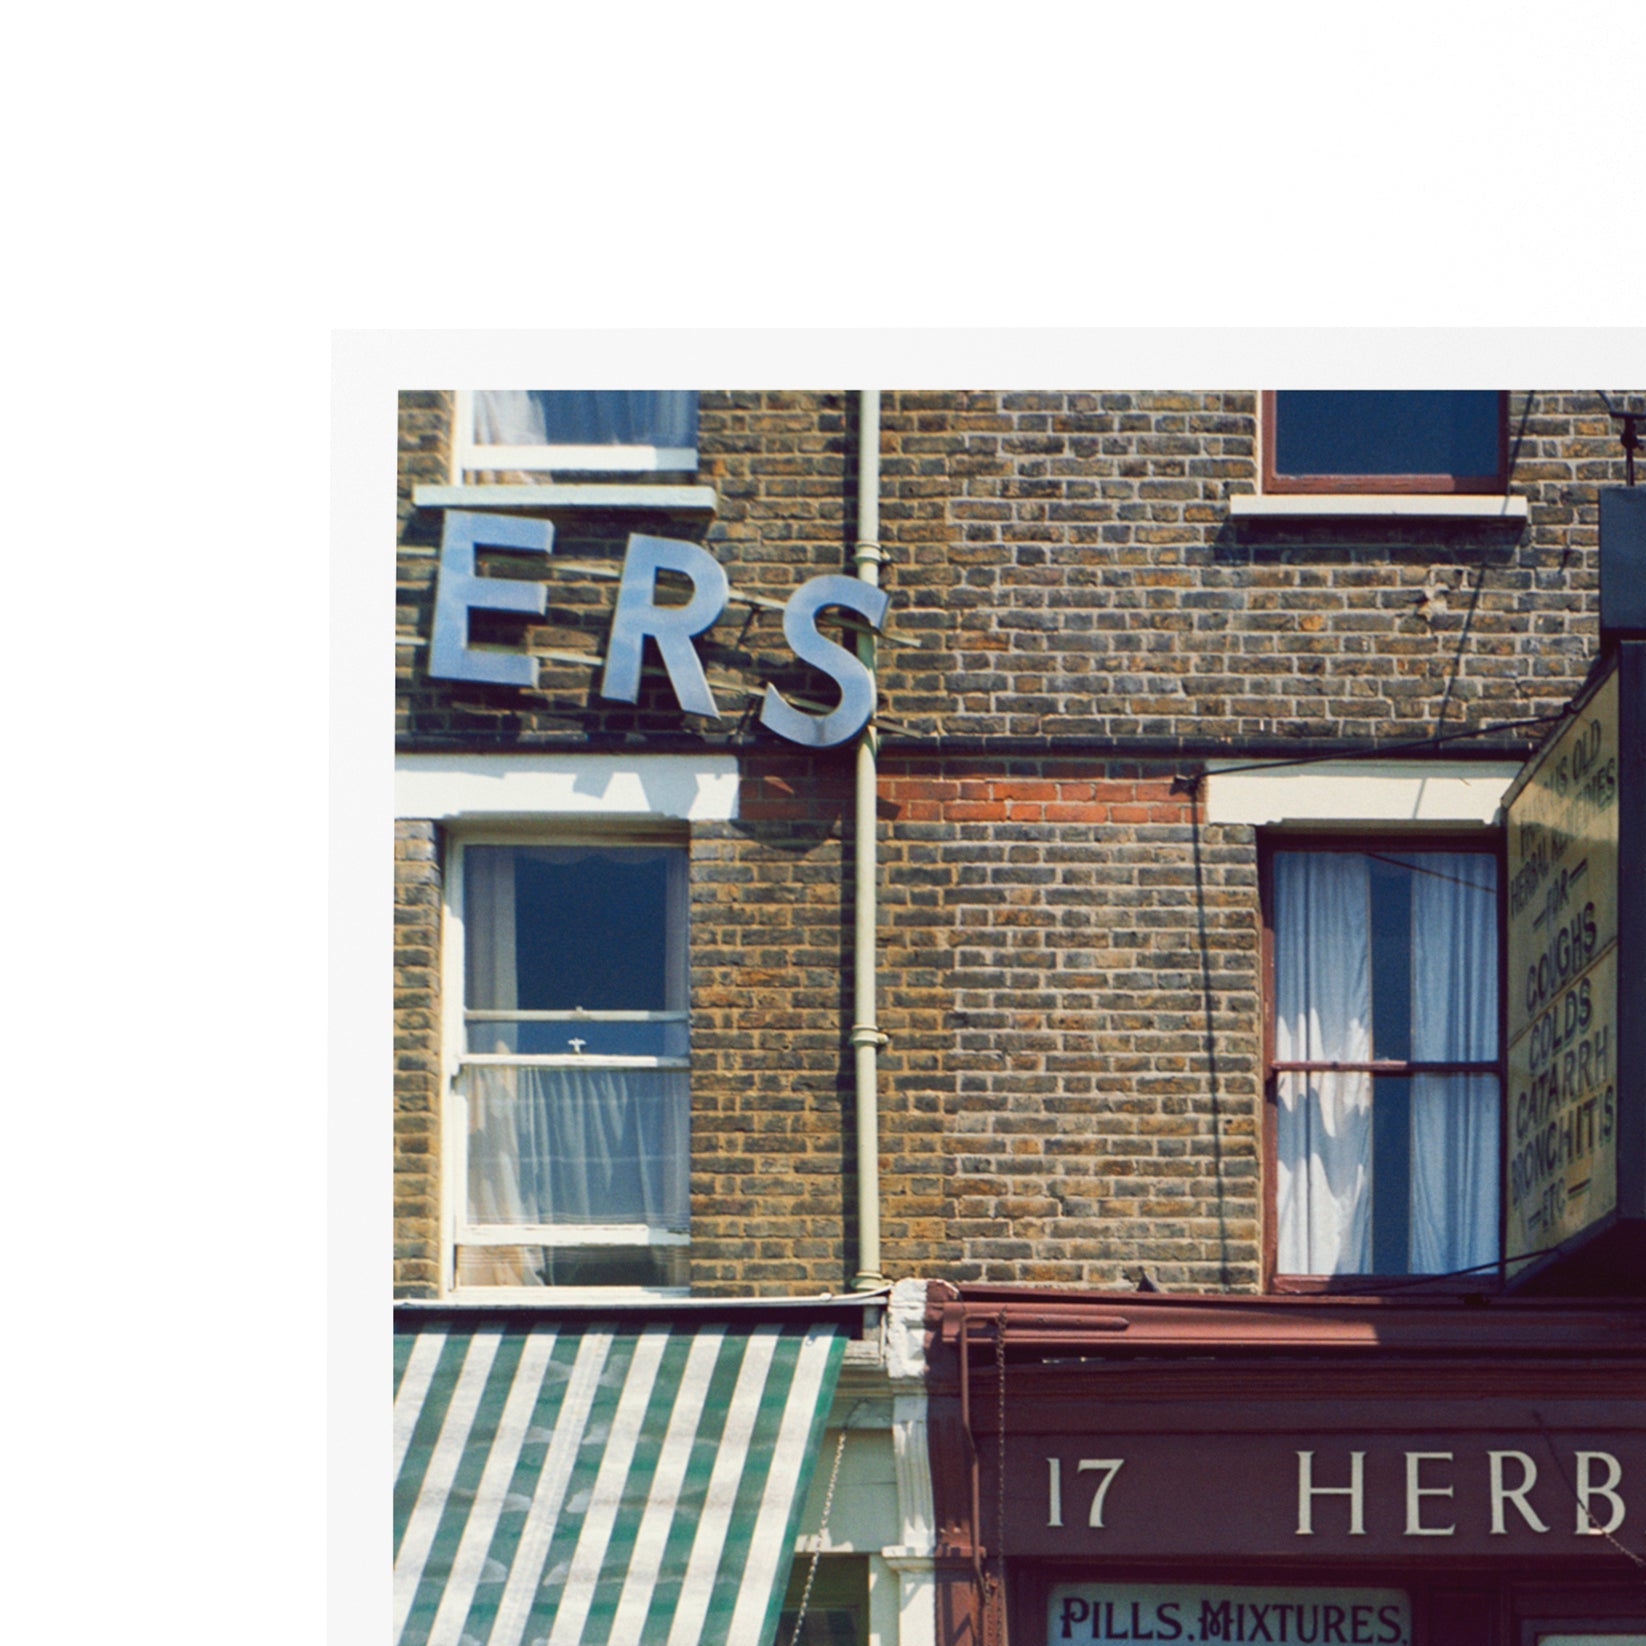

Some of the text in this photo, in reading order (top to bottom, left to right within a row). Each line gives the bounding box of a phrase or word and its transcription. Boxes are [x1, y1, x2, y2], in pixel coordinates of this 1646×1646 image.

[428, 509, 890, 748] ERS
[1572, 719, 1602, 782] OLD
[1526, 901, 1597, 1013] COUGHS
[1528, 976, 1593, 1071] COLDS
[1515, 1024, 1609, 1140] CATARRH
[1045, 1457, 1126, 1528] 17
